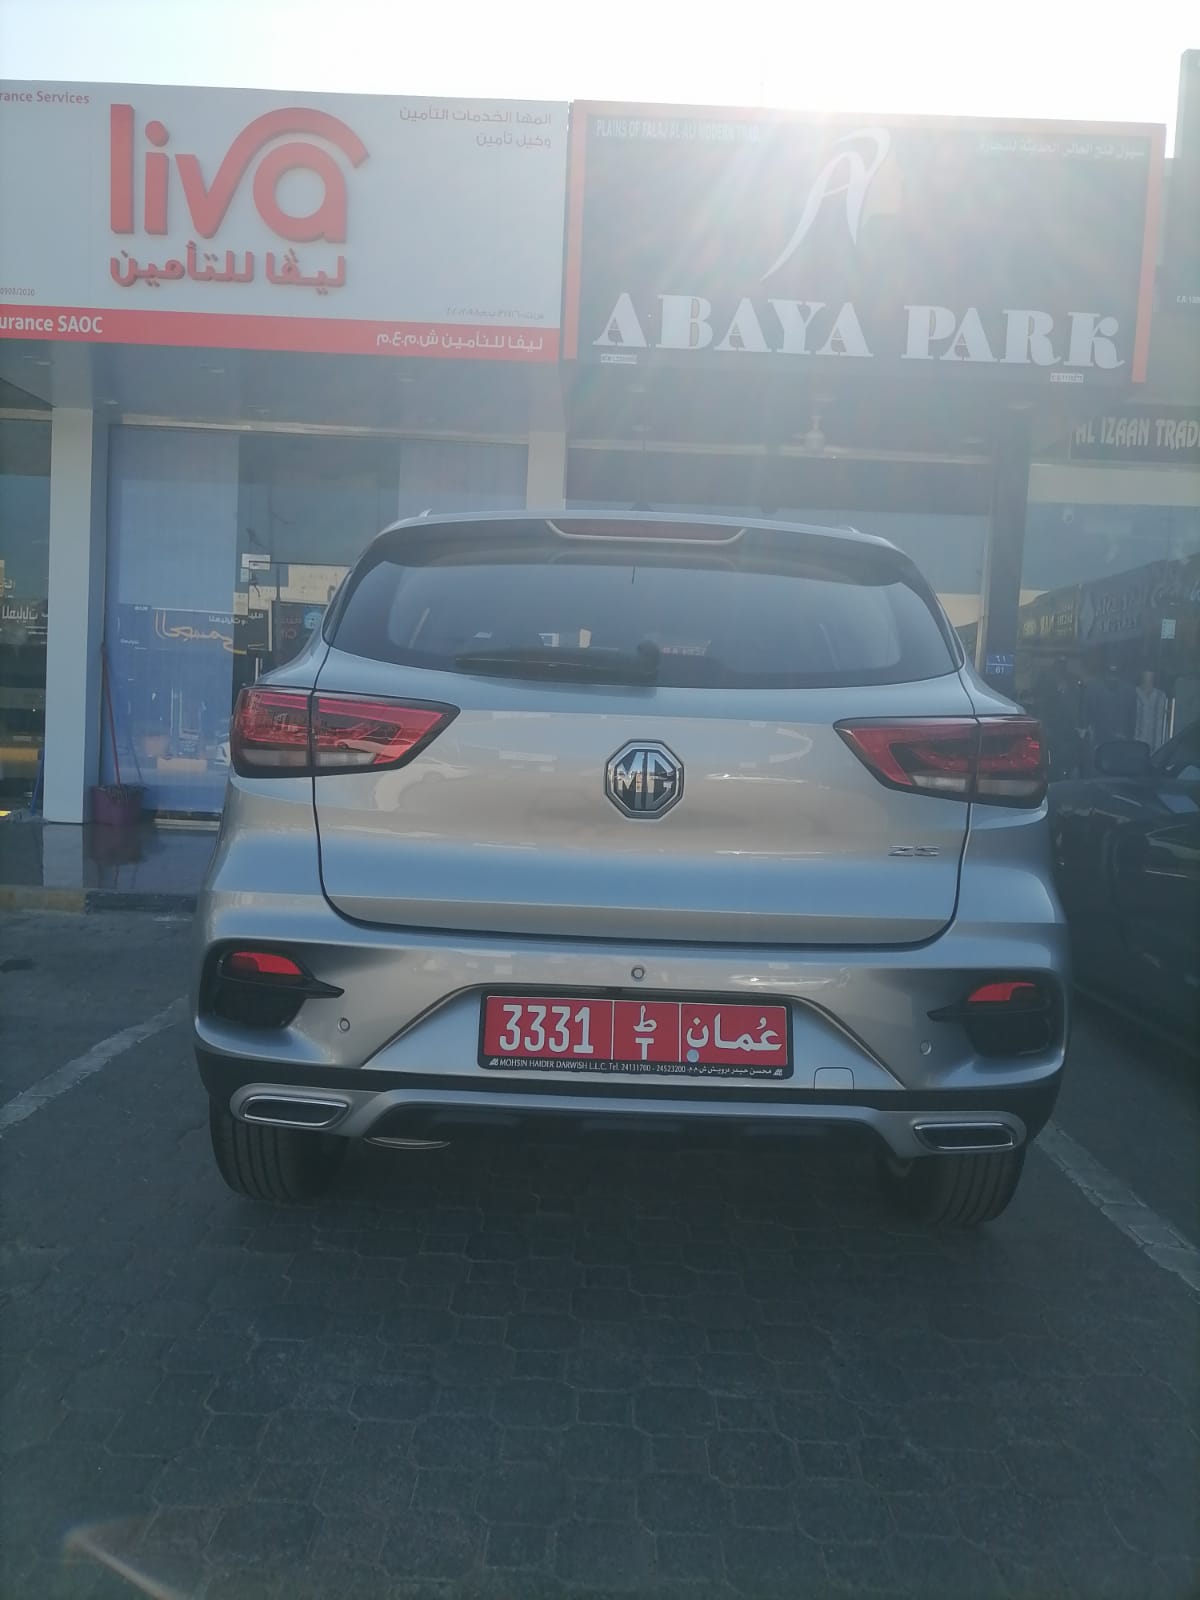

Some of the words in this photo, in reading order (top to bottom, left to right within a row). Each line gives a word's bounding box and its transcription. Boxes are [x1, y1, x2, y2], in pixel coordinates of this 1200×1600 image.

[0, 91, 33, 103] rance
[36, 90, 90, 104] Services
[452, 109, 512, 123] الخدمات
[596, 118, 626, 137] PLAINS
[515, 134, 552, 149] وكيل
[109, 103, 371, 244] liva
[109, 240, 255, 287] للتأمين
[0, 316, 54, 332] urance
[57, 315, 104, 334] SAOC
[593, 292, 874, 358] ABAYA
[901, 304, 1125, 369] PARK
[1074, 420, 1096, 446] AL
[1100, 416, 1150, 448] IZAAN
[614, 750, 675, 812] MG
[887, 844, 941, 858] ZS
[499, 1004, 594, 1056] 3331
[632, 1004, 658, 1033] ط
[635, 1038, 655, 1061] T
[499, 1058, 528, 1068] MOHSIN
[529, 1060, 555, 1069] HAIDER
[555, 1061, 588, 1070] DARWISH
[656, 1064, 686, 1073] 24523200
